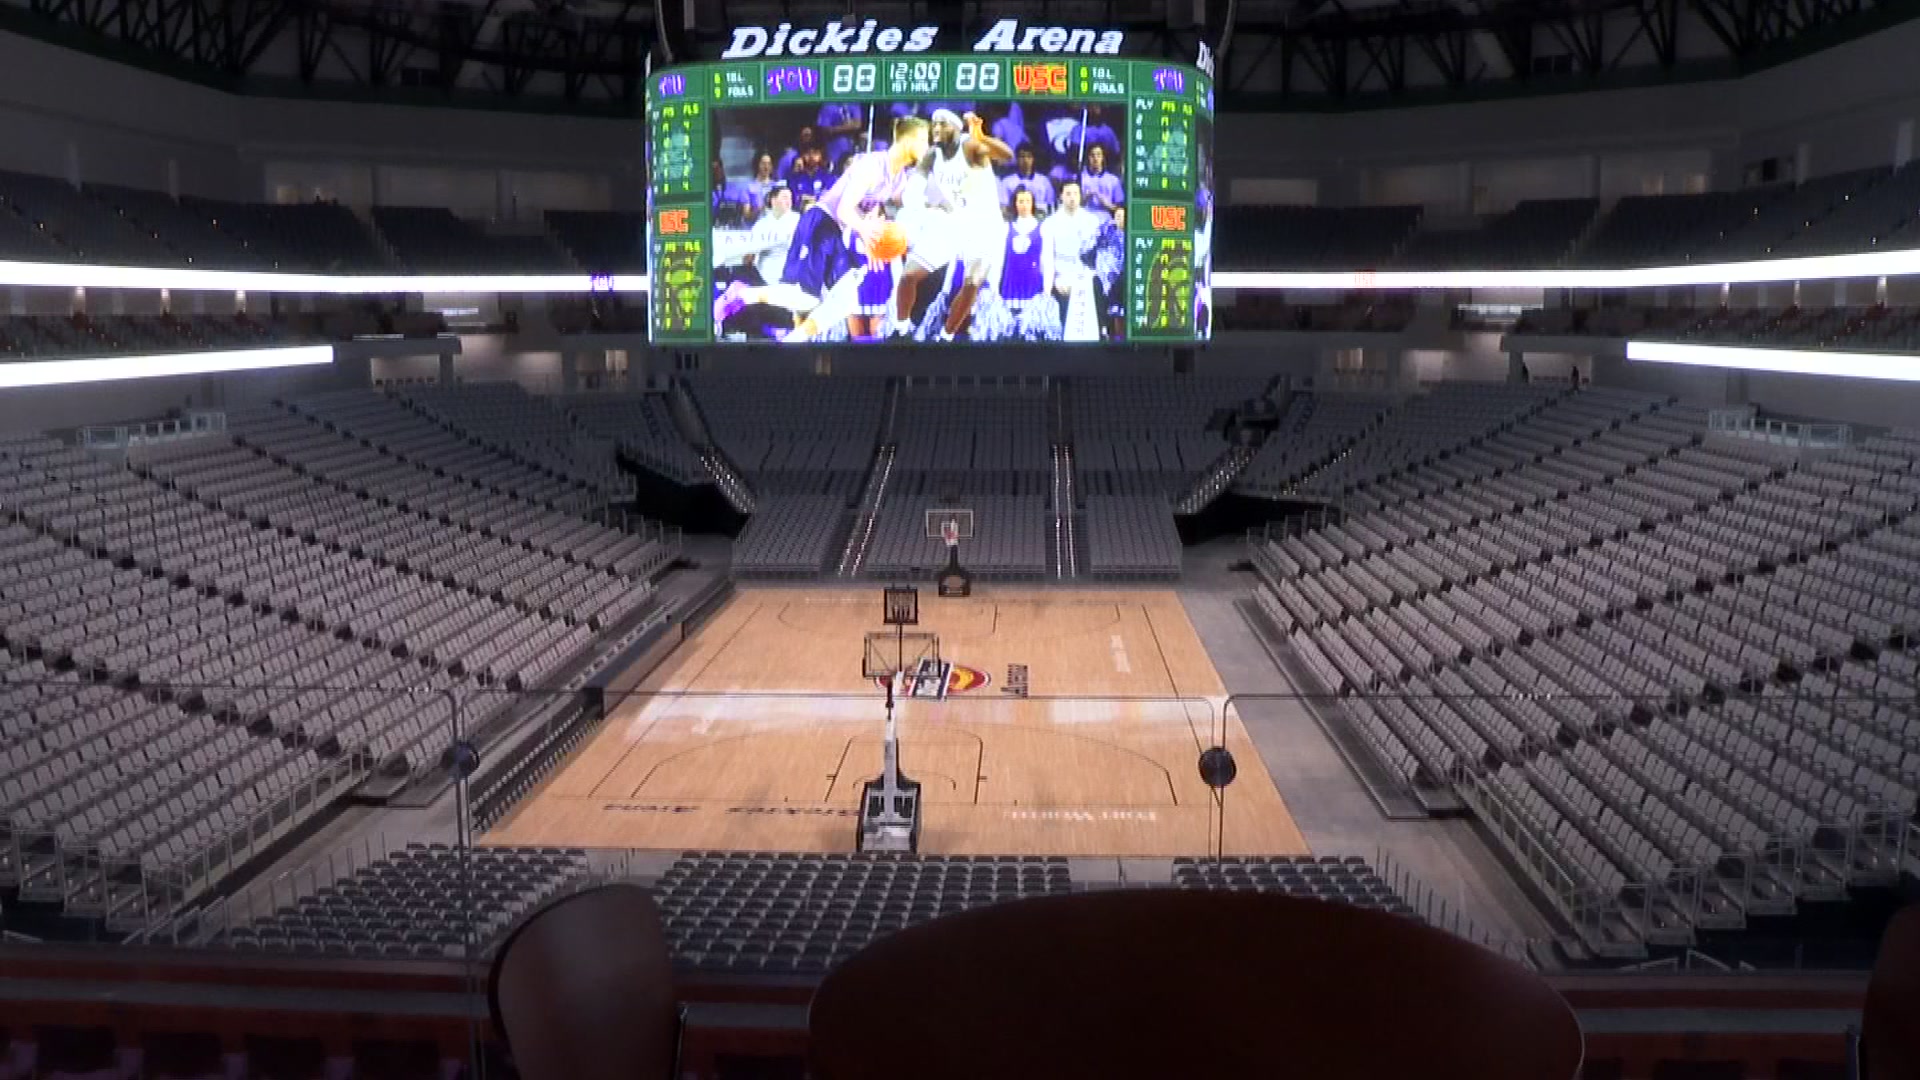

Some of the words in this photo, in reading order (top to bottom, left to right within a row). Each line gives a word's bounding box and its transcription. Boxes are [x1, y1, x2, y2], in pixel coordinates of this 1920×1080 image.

[721, 18, 940, 59] Dickies
[973, 18, 1123, 54] Arena
[833, 64, 876, 93] 88
[890, 62, 941, 81] 12:00
[955, 62, 1000, 91] 88
[1013, 61, 1067, 94] USC
[1151, 205, 1186, 231] USC
